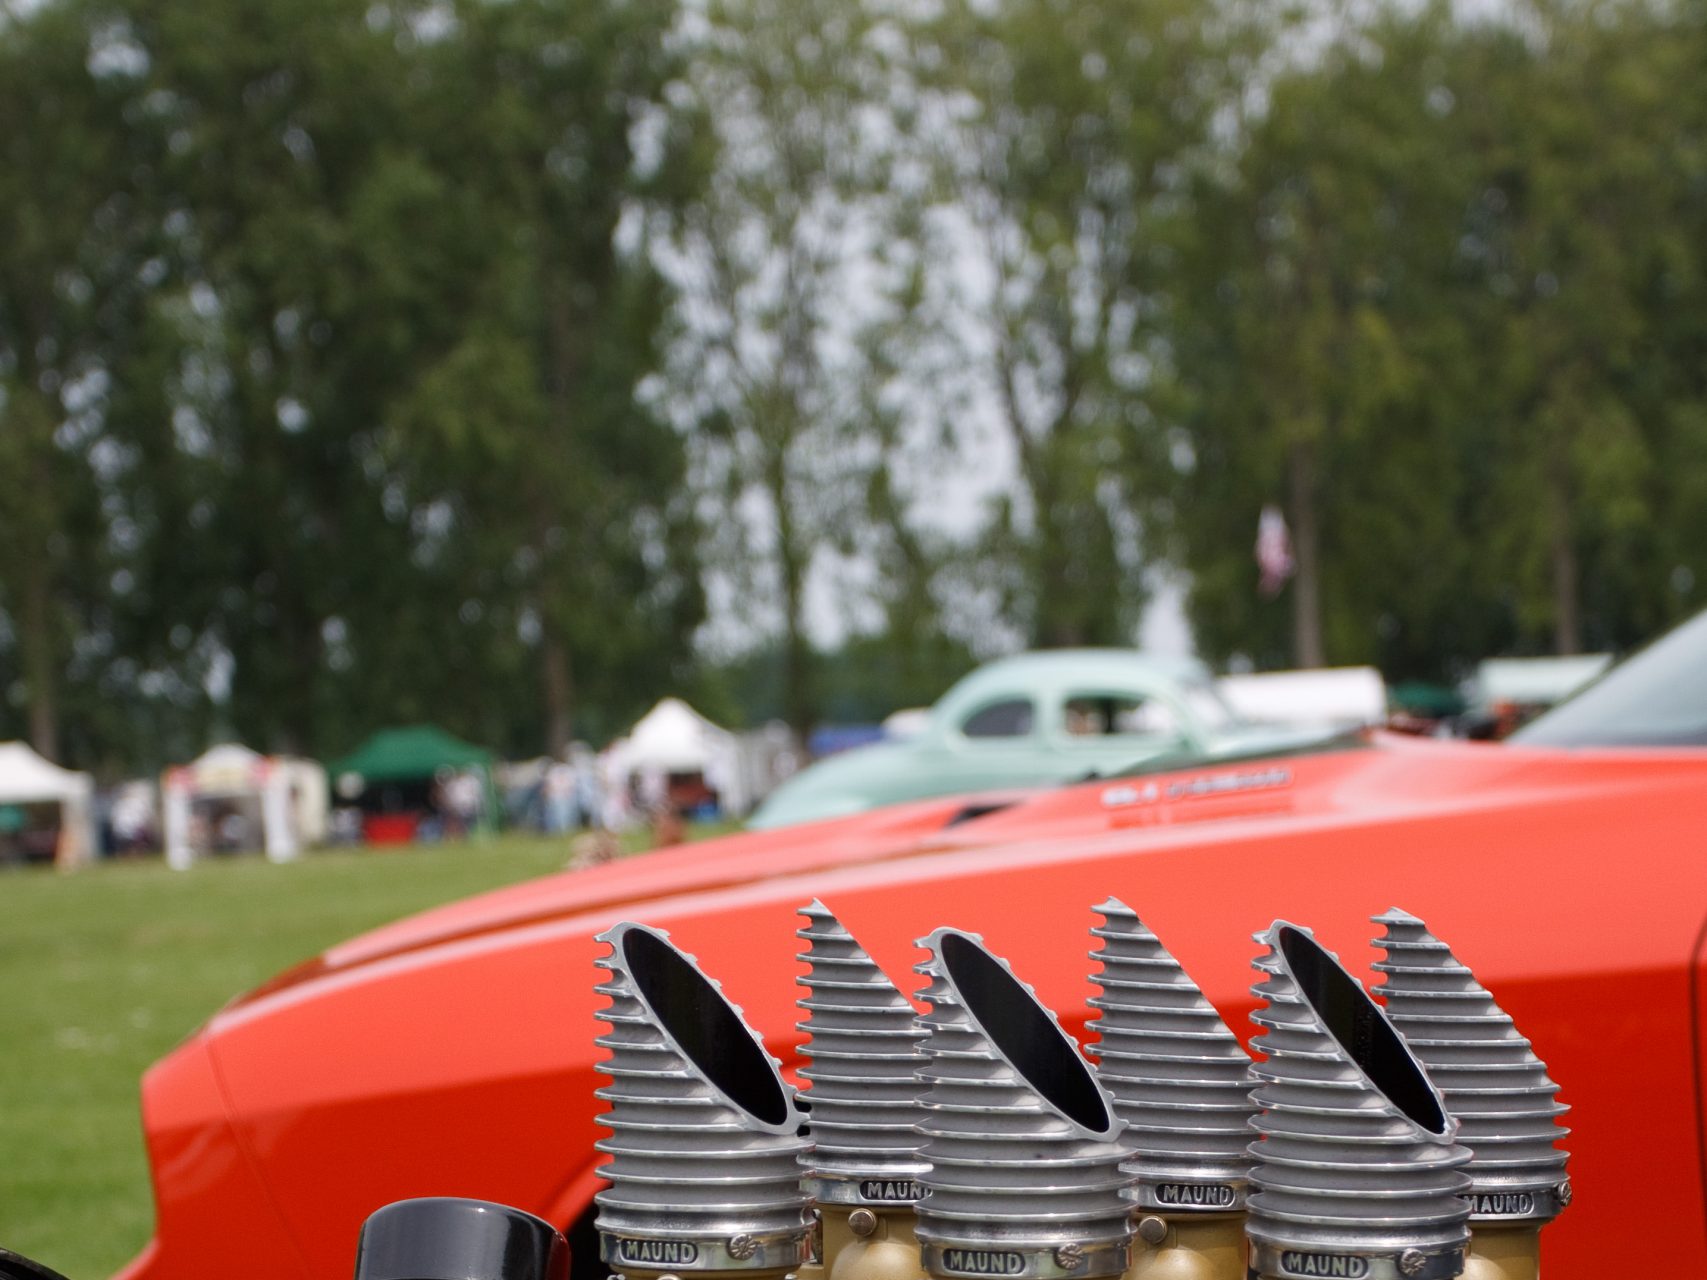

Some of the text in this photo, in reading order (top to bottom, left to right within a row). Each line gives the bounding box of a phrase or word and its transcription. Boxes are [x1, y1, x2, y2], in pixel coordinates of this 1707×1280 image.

[1163, 1185, 1231, 1205] MAUND
[626, 1240, 695, 1263] MAUND
[950, 1250, 1022, 1274] MAUND
[1287, 1253, 1364, 1278] MAUND
